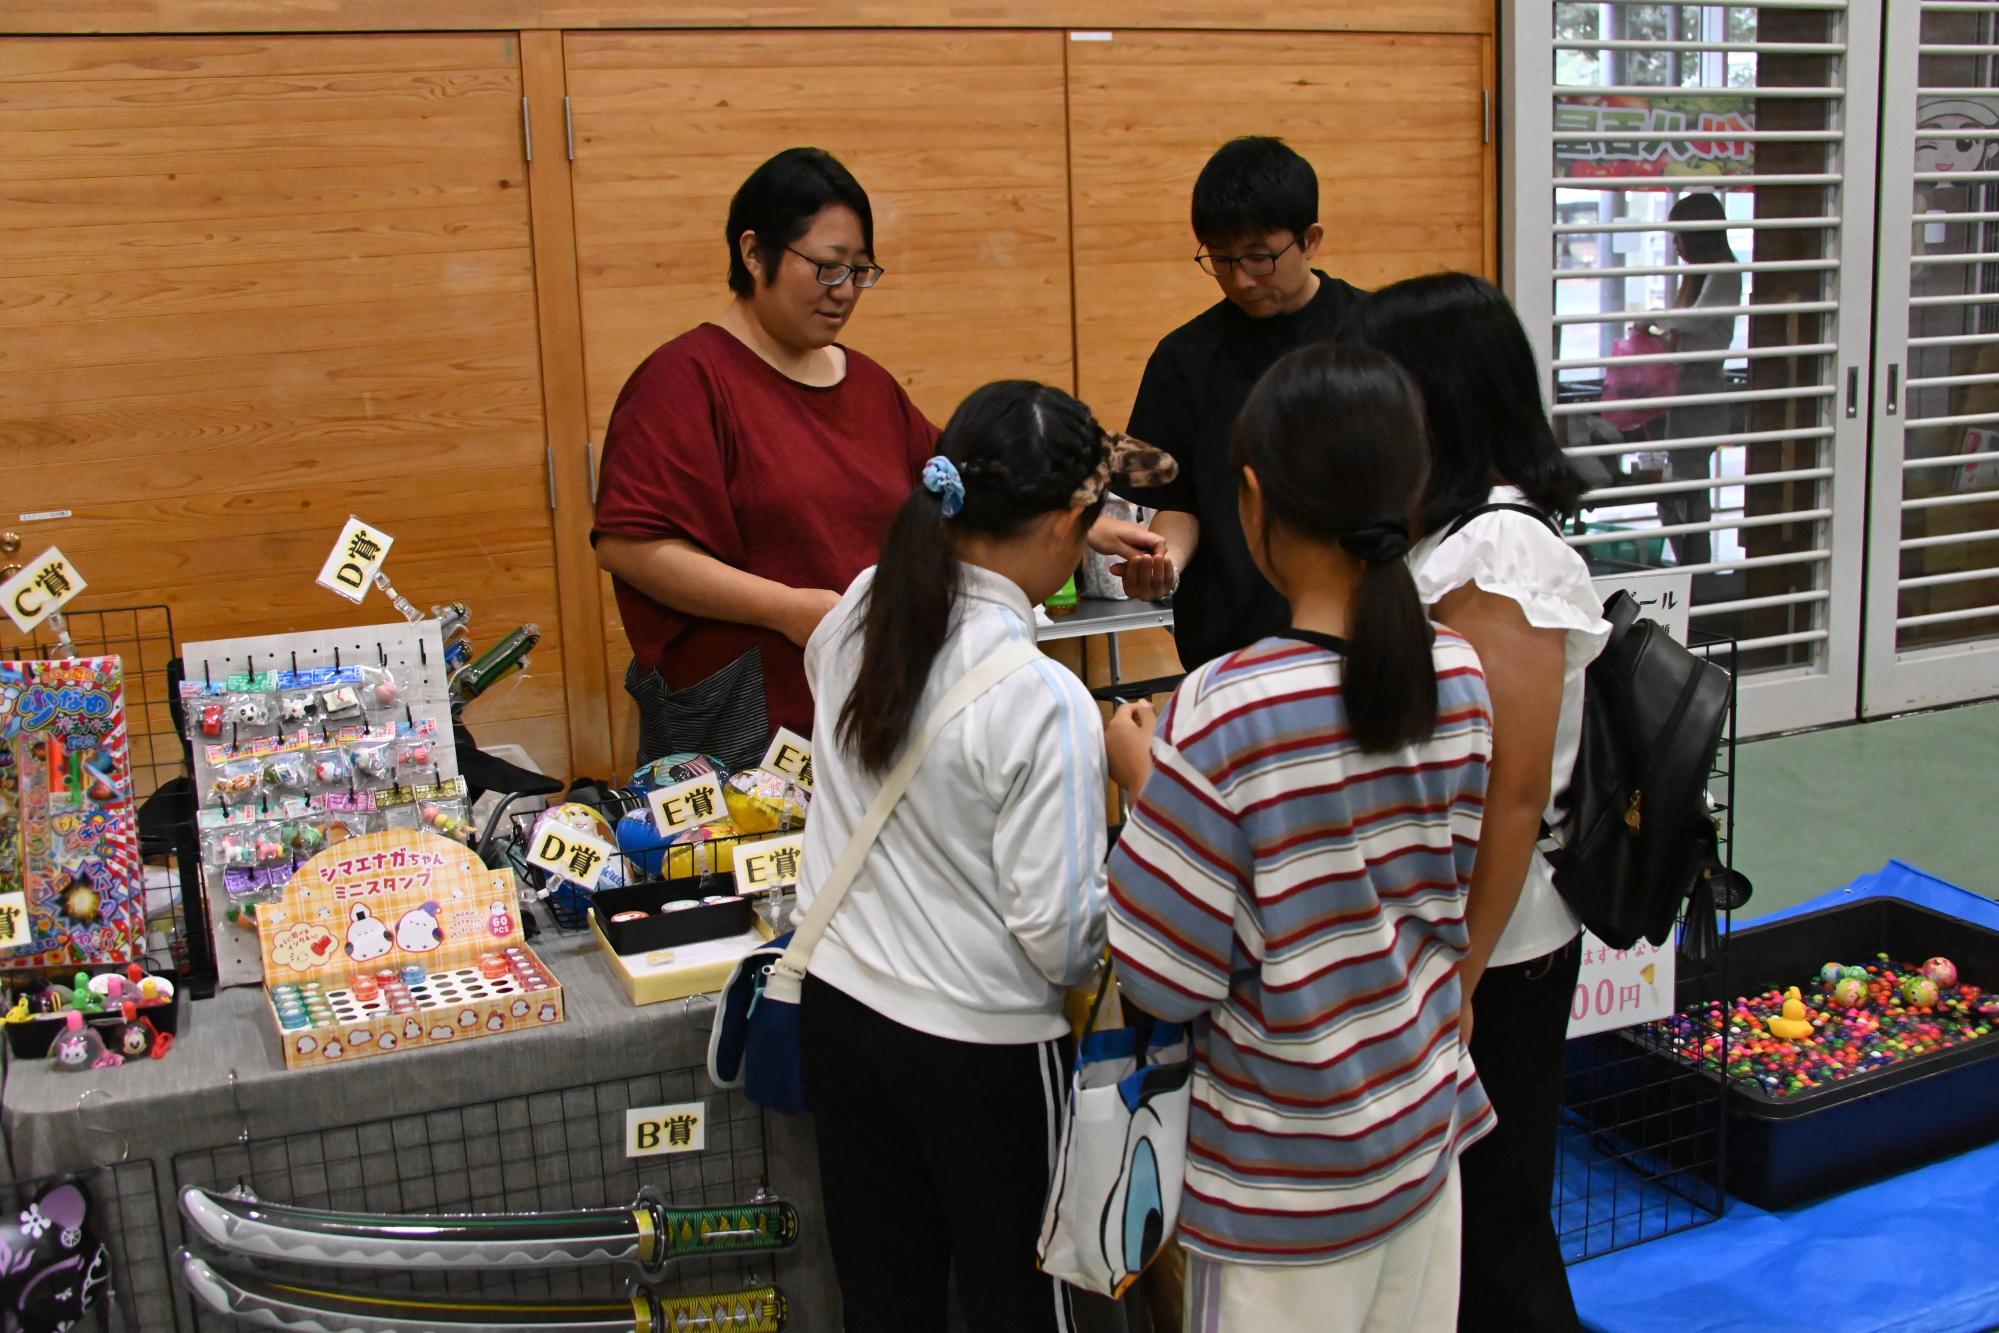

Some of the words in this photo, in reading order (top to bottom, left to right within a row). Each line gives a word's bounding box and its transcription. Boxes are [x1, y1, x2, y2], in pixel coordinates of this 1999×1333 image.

[336, 530, 382, 588] D賞
[15, 562, 71, 617] C賞
[20, 688, 110, 729] 少なめ
[662, 786, 714, 826] E賞
[319, 847, 445, 883] シマエナガちゃん
[539, 834, 601, 878] D賞
[745, 847, 801, 884] E賞
[335, 869, 433, 900] ミニスタンプ
[492, 916, 508, 927] 60
[493, 926, 510, 934] PCS
[637, 1115, 698, 1149] B賞
